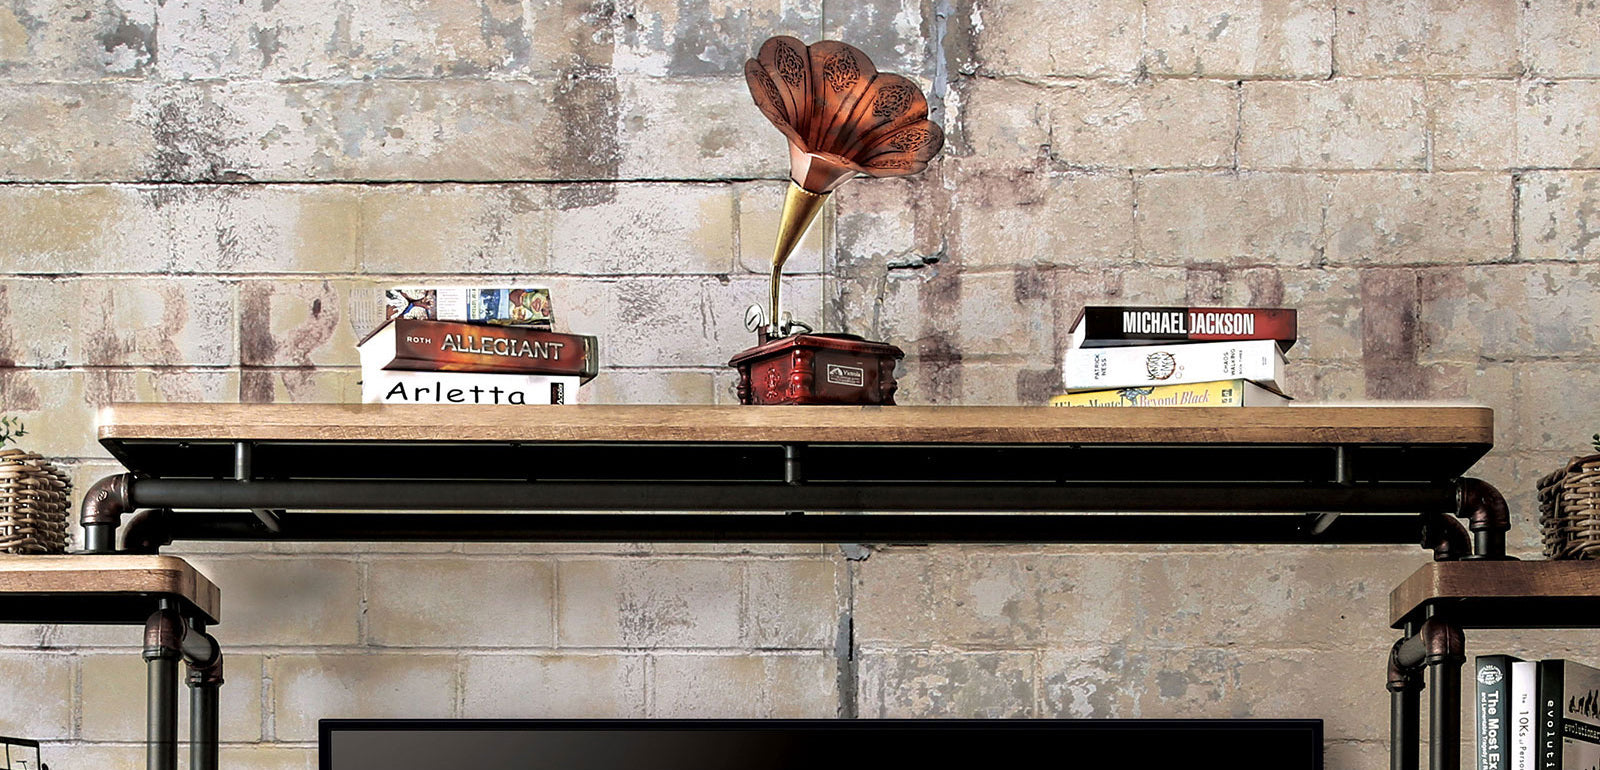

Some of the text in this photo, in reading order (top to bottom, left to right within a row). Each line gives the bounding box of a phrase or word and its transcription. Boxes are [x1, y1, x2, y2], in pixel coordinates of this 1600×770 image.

[1123, 311, 1254, 335] MICHAEL JACKSON
[406, 333, 564, 361] ROTH ALLEGIANT
[385, 381, 526, 405] Arletta
[1140, 389, 1209, 407] Beyond Black
[1488, 690, 1500, 770] The Most Ex
[1518, 711, 1529, 737] 10Ks
[1564, 723, 1600, 741] evolutionar
[1519, 746, 1527, 770] Perso
